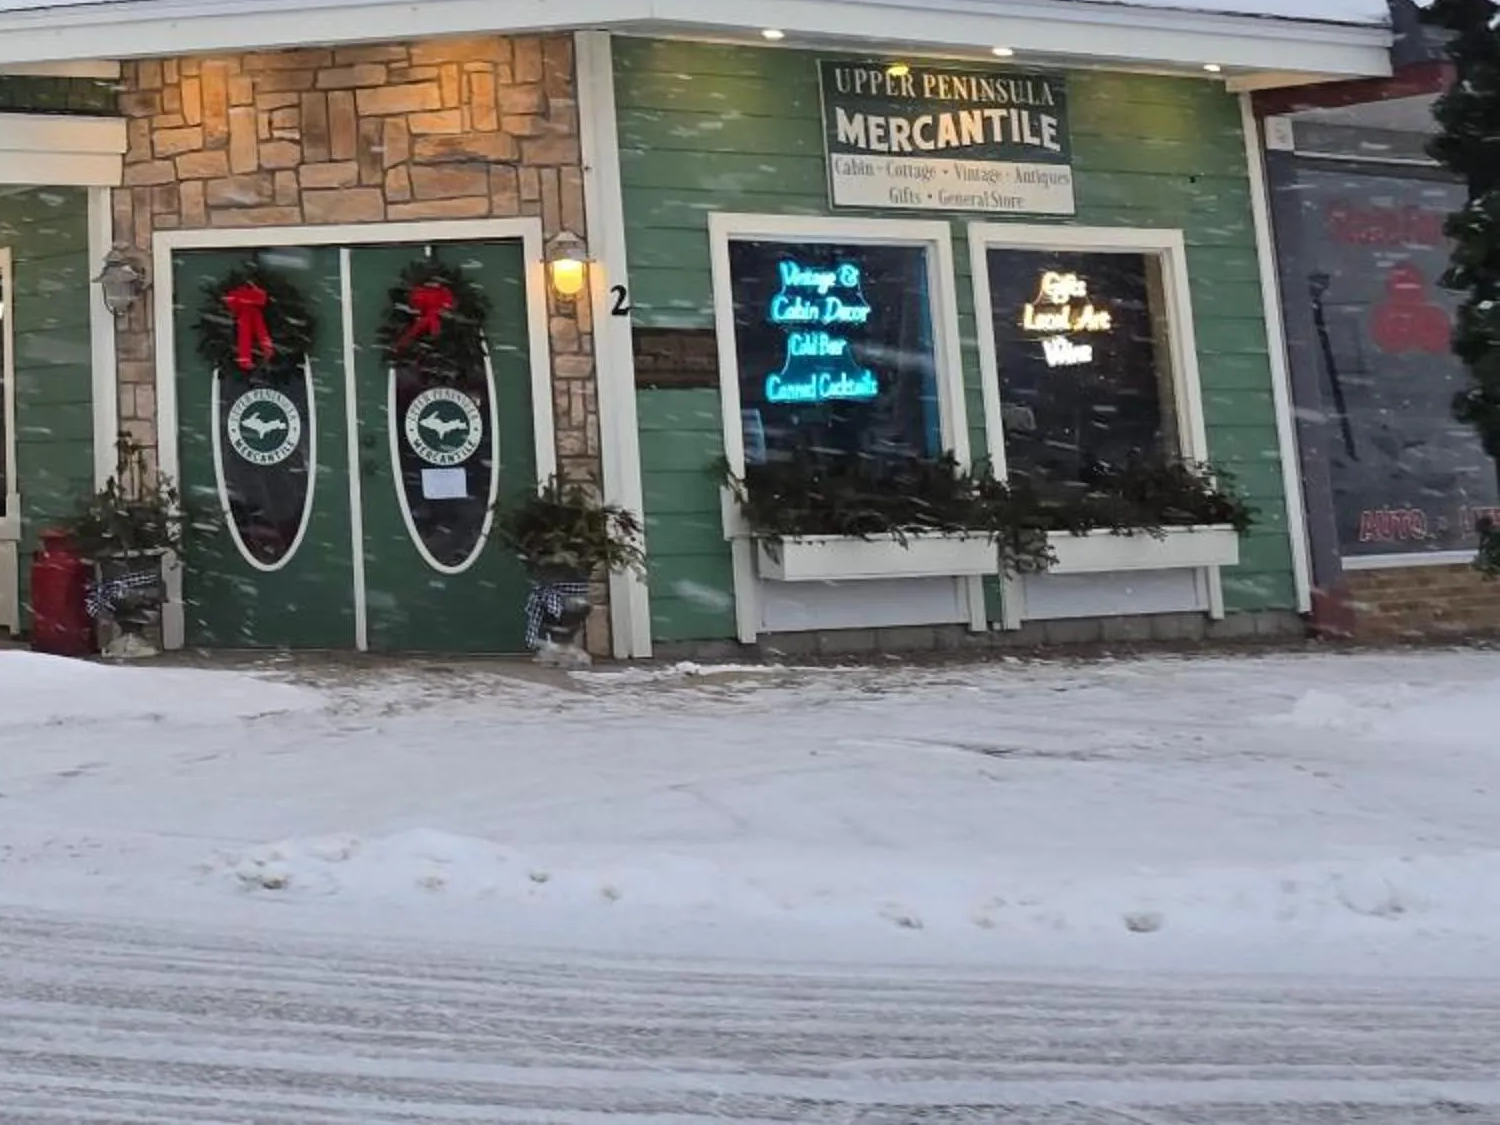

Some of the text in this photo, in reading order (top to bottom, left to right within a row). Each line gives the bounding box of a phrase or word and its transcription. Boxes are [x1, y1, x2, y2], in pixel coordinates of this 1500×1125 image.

[835, 67, 1055, 107] UPPER PENINSULA
[836, 106, 1061, 152] MERCANTILE
[835, 157, 1070, 188] Cabin Cottage Vintage Antiques
[889, 187, 1026, 209] Gifts General Store
[610, 284, 633, 316] 2
[771, 295, 872, 325] Cabin Decor
[1359, 507, 1428, 543] AUTO
